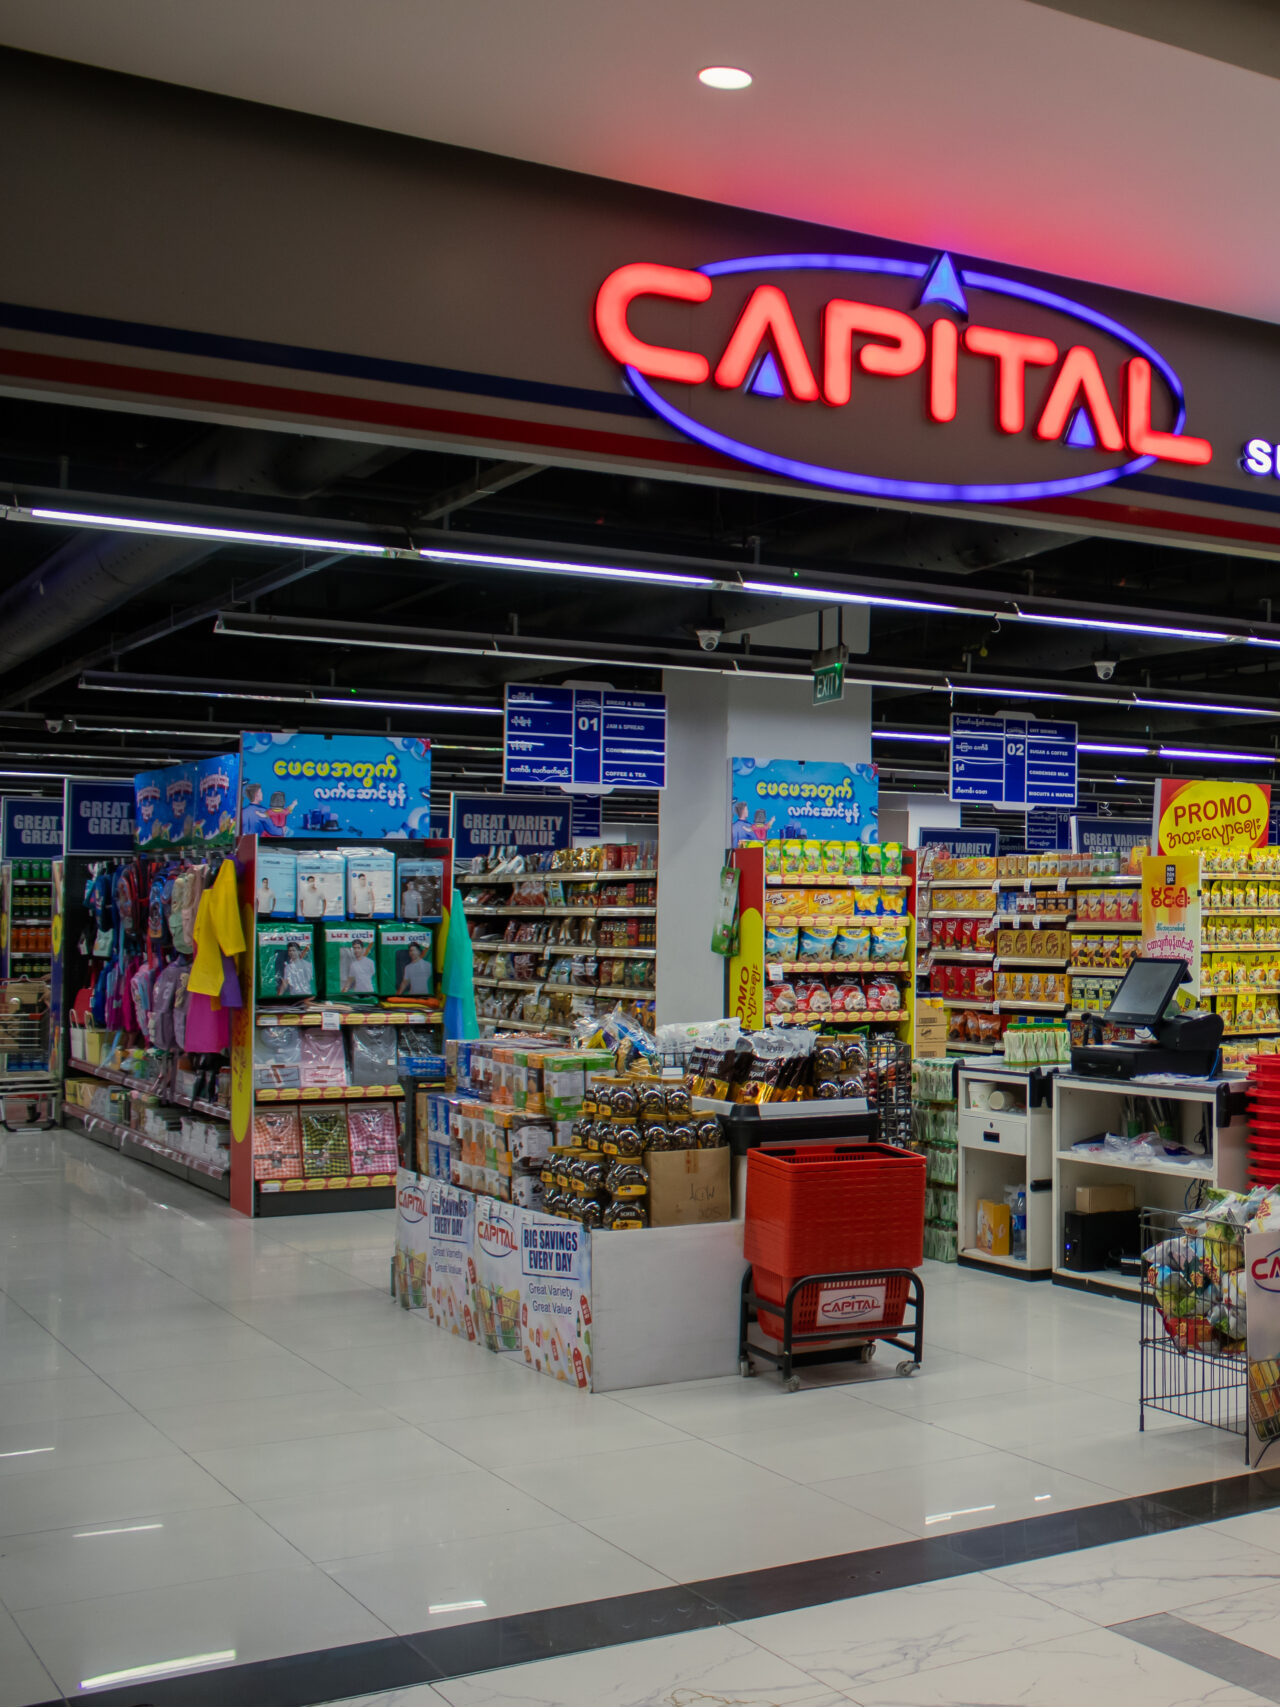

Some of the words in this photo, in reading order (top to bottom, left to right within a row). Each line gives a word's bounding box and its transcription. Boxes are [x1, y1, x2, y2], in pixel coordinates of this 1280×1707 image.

[594, 261, 1213, 467] CAPITAL
[816, 673, 834, 698] EXIT
[577, 715, 599, 732] 01
[1006, 742, 1025, 756] 02
[605, 770, 628, 778] COFFEE
[79, 800, 131, 819] GREAT
[1058, 813, 1069, 823] 10
[1173, 793, 1252, 827] PROMO
[13, 814, 60, 830] GREAT
[463, 814, 508, 830] GREAT
[508, 814, 564, 831] VARIETY
[470, 829, 507, 846] GREAT
[509, 831, 555, 847] VALUE
[1083, 832, 1114, 846] GREAT
[955, 841, 992, 857] VARIETY
[398, 1190, 428, 1217] CAPITAL
[440, 1198, 468, 1218] SAVINGS
[435, 1216, 451, 1235] EVERY
[452, 1218, 464, 1236] DAY
[477, 1221, 518, 1251] CAPITAL
[523, 1228, 538, 1248] BIG
[539, 1230, 578, 1252] SAVINGS
[529, 1250, 553, 1271] EVERY
[555, 1252, 573, 1273] DAY
[528, 1282, 547, 1296] Great
[548, 1284, 573, 1300] Variety
[532, 1300, 551, 1313] Great
[552, 1302, 573, 1315] Value
[821, 1299, 881, 1313] CAPITAL
